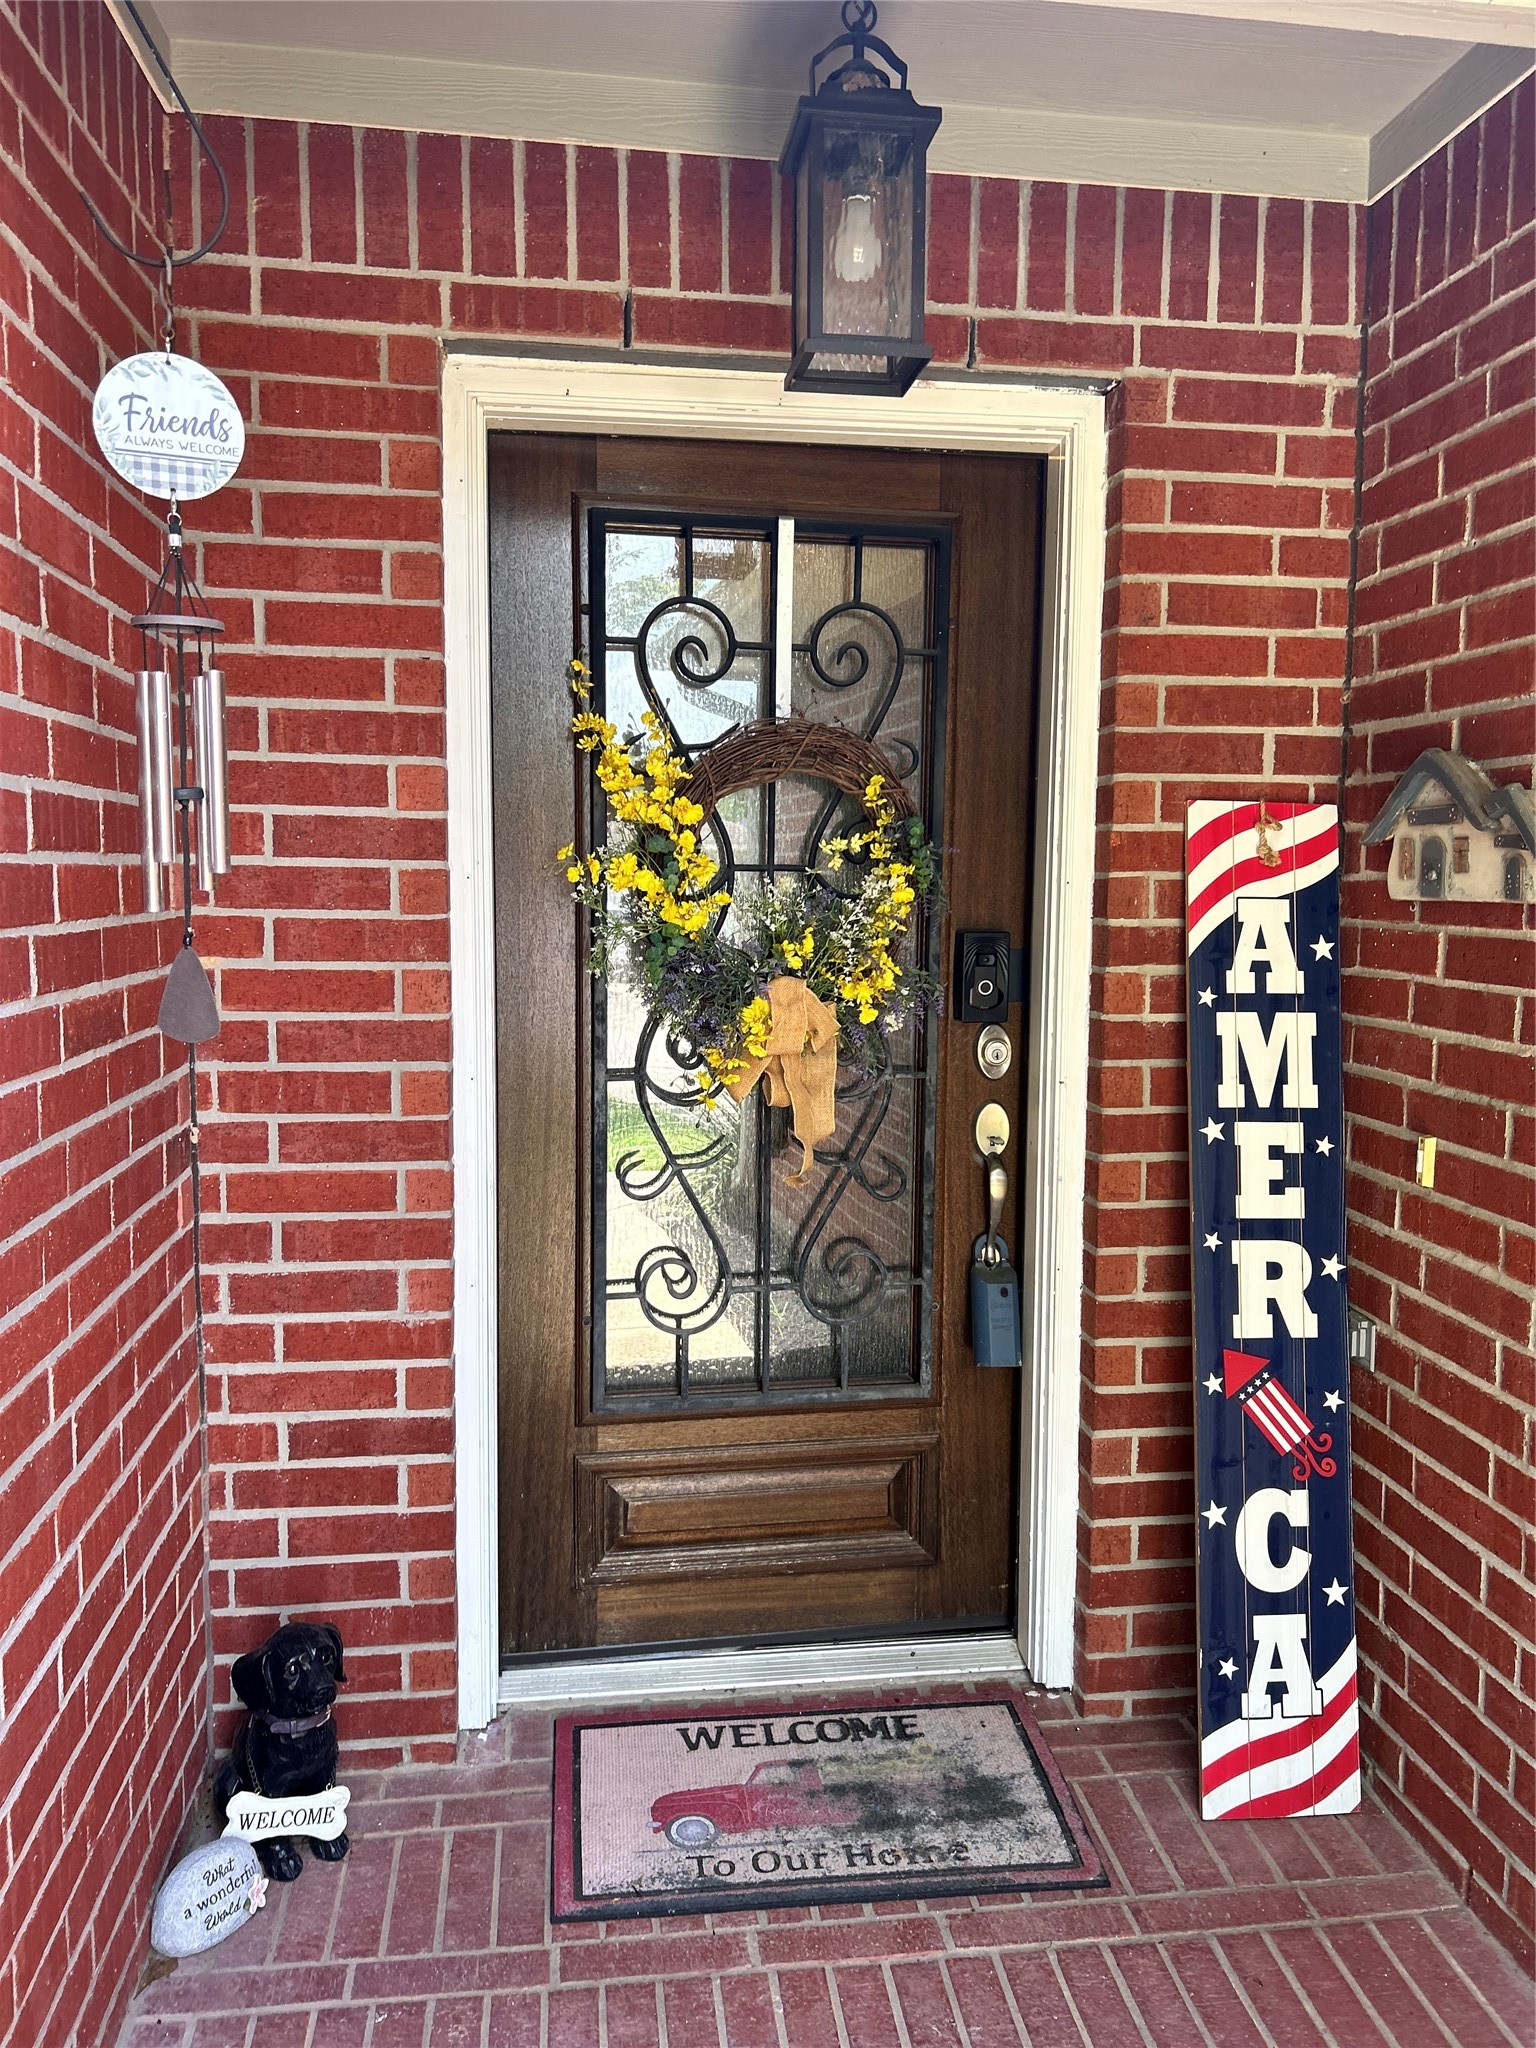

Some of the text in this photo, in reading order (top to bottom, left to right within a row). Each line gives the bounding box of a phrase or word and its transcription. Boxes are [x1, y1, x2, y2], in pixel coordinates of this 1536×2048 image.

[118, 392, 232, 443] Friends
[124, 435, 240, 457] ALWAYS WELCOME
[676, 1714, 920, 1753] WELCOME
[239, 1806, 336, 1831] WELCOME
[203, 1857, 235, 1887] What
[685, 1855, 736, 1878] To
[752, 1850, 828, 1873] Our
[184, 1858, 257, 1920] a wonderful
[204, 1896, 241, 1931] World
